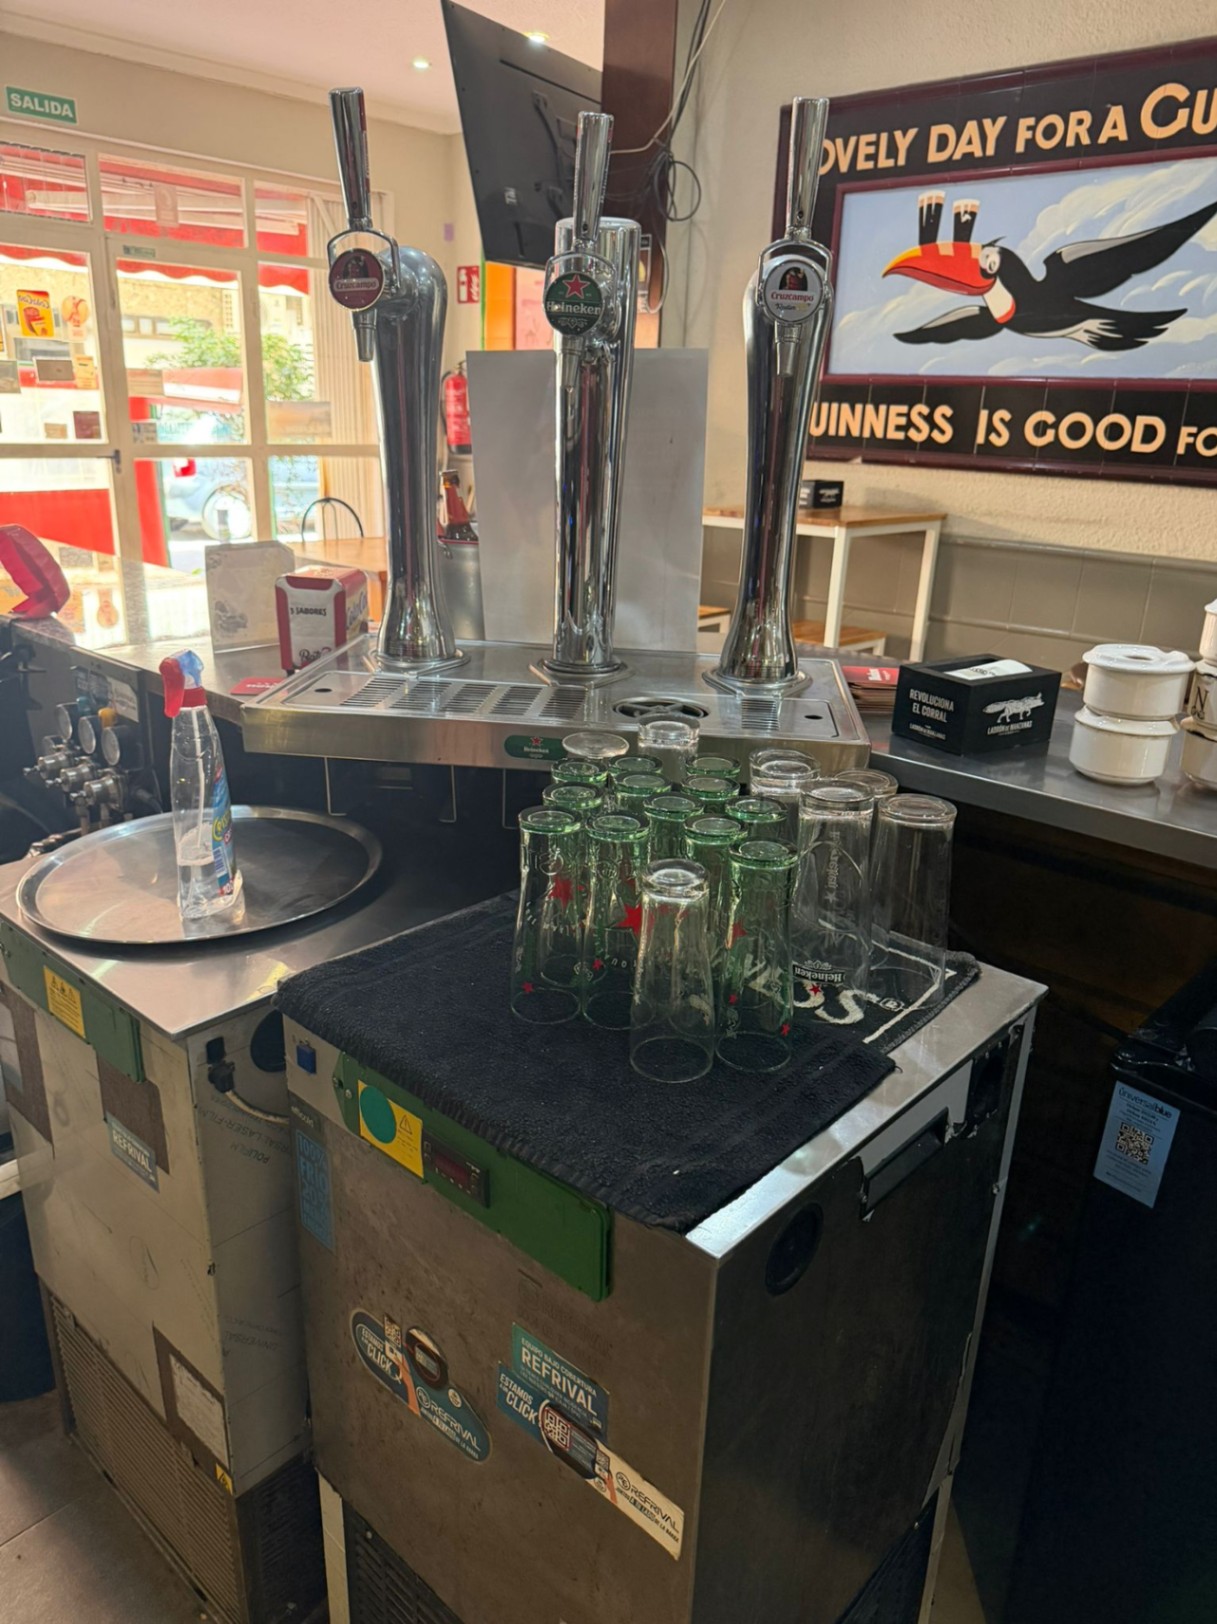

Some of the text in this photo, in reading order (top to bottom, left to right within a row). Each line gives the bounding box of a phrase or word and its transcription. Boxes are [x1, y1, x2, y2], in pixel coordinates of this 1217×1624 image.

[10, 93, 74, 119] SALIDA
[926, 115, 1006, 164] DAY
[1015, 110, 1092, 153] FOR
[1097, 105, 1129, 144] A
[1140, 83, 1217, 139] GU
[546, 301, 601, 316] Heineken
[770, 292, 814, 303] Cruzcampo
[809, 402, 1217, 457] UINNESS IS GOOD FO
[296, 607, 327, 617] SABORES
[909, 688, 955, 711] REVOLUCIONA
[912, 702, 948, 723] EL CORRAL
[794, 966, 844, 983] Heineken
[367, 1343, 393, 1375] CLICK
[543, 1354, 560, 1370] BAJO
[500, 1373, 534, 1405] ESTAMOS
[521, 1347, 598, 1417] REFRIVAL
[506, 1391, 538, 1424] CLICK
[430, 1402, 481, 1452] REFRIVAL
[630, 1485, 679, 1534] REFRIVAL
